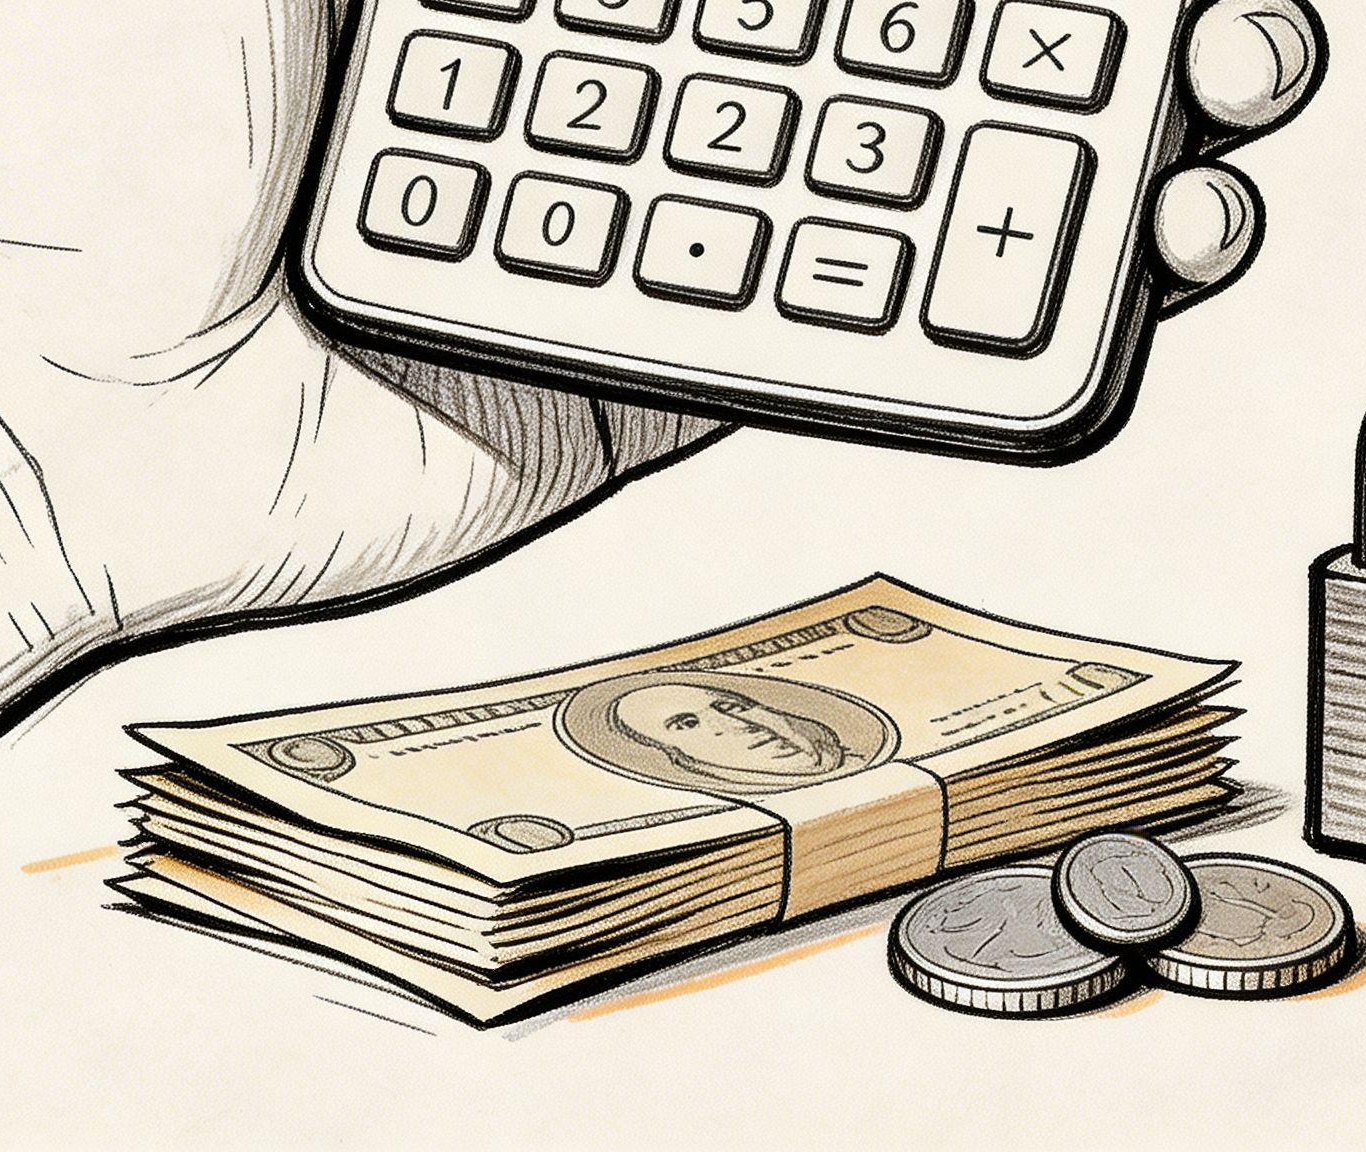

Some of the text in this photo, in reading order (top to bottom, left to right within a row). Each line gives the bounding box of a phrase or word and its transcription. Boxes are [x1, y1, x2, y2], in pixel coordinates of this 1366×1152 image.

[879, 1, 919, 54] 6
[440, 57, 462, 111] 1
[566, 79, 608, 131] 2
[706, 100, 747, 153] 2
[845, 121, 887, 174] 3
[401, 174, 438, 227] 0
[542, 201, 576, 247] 0
